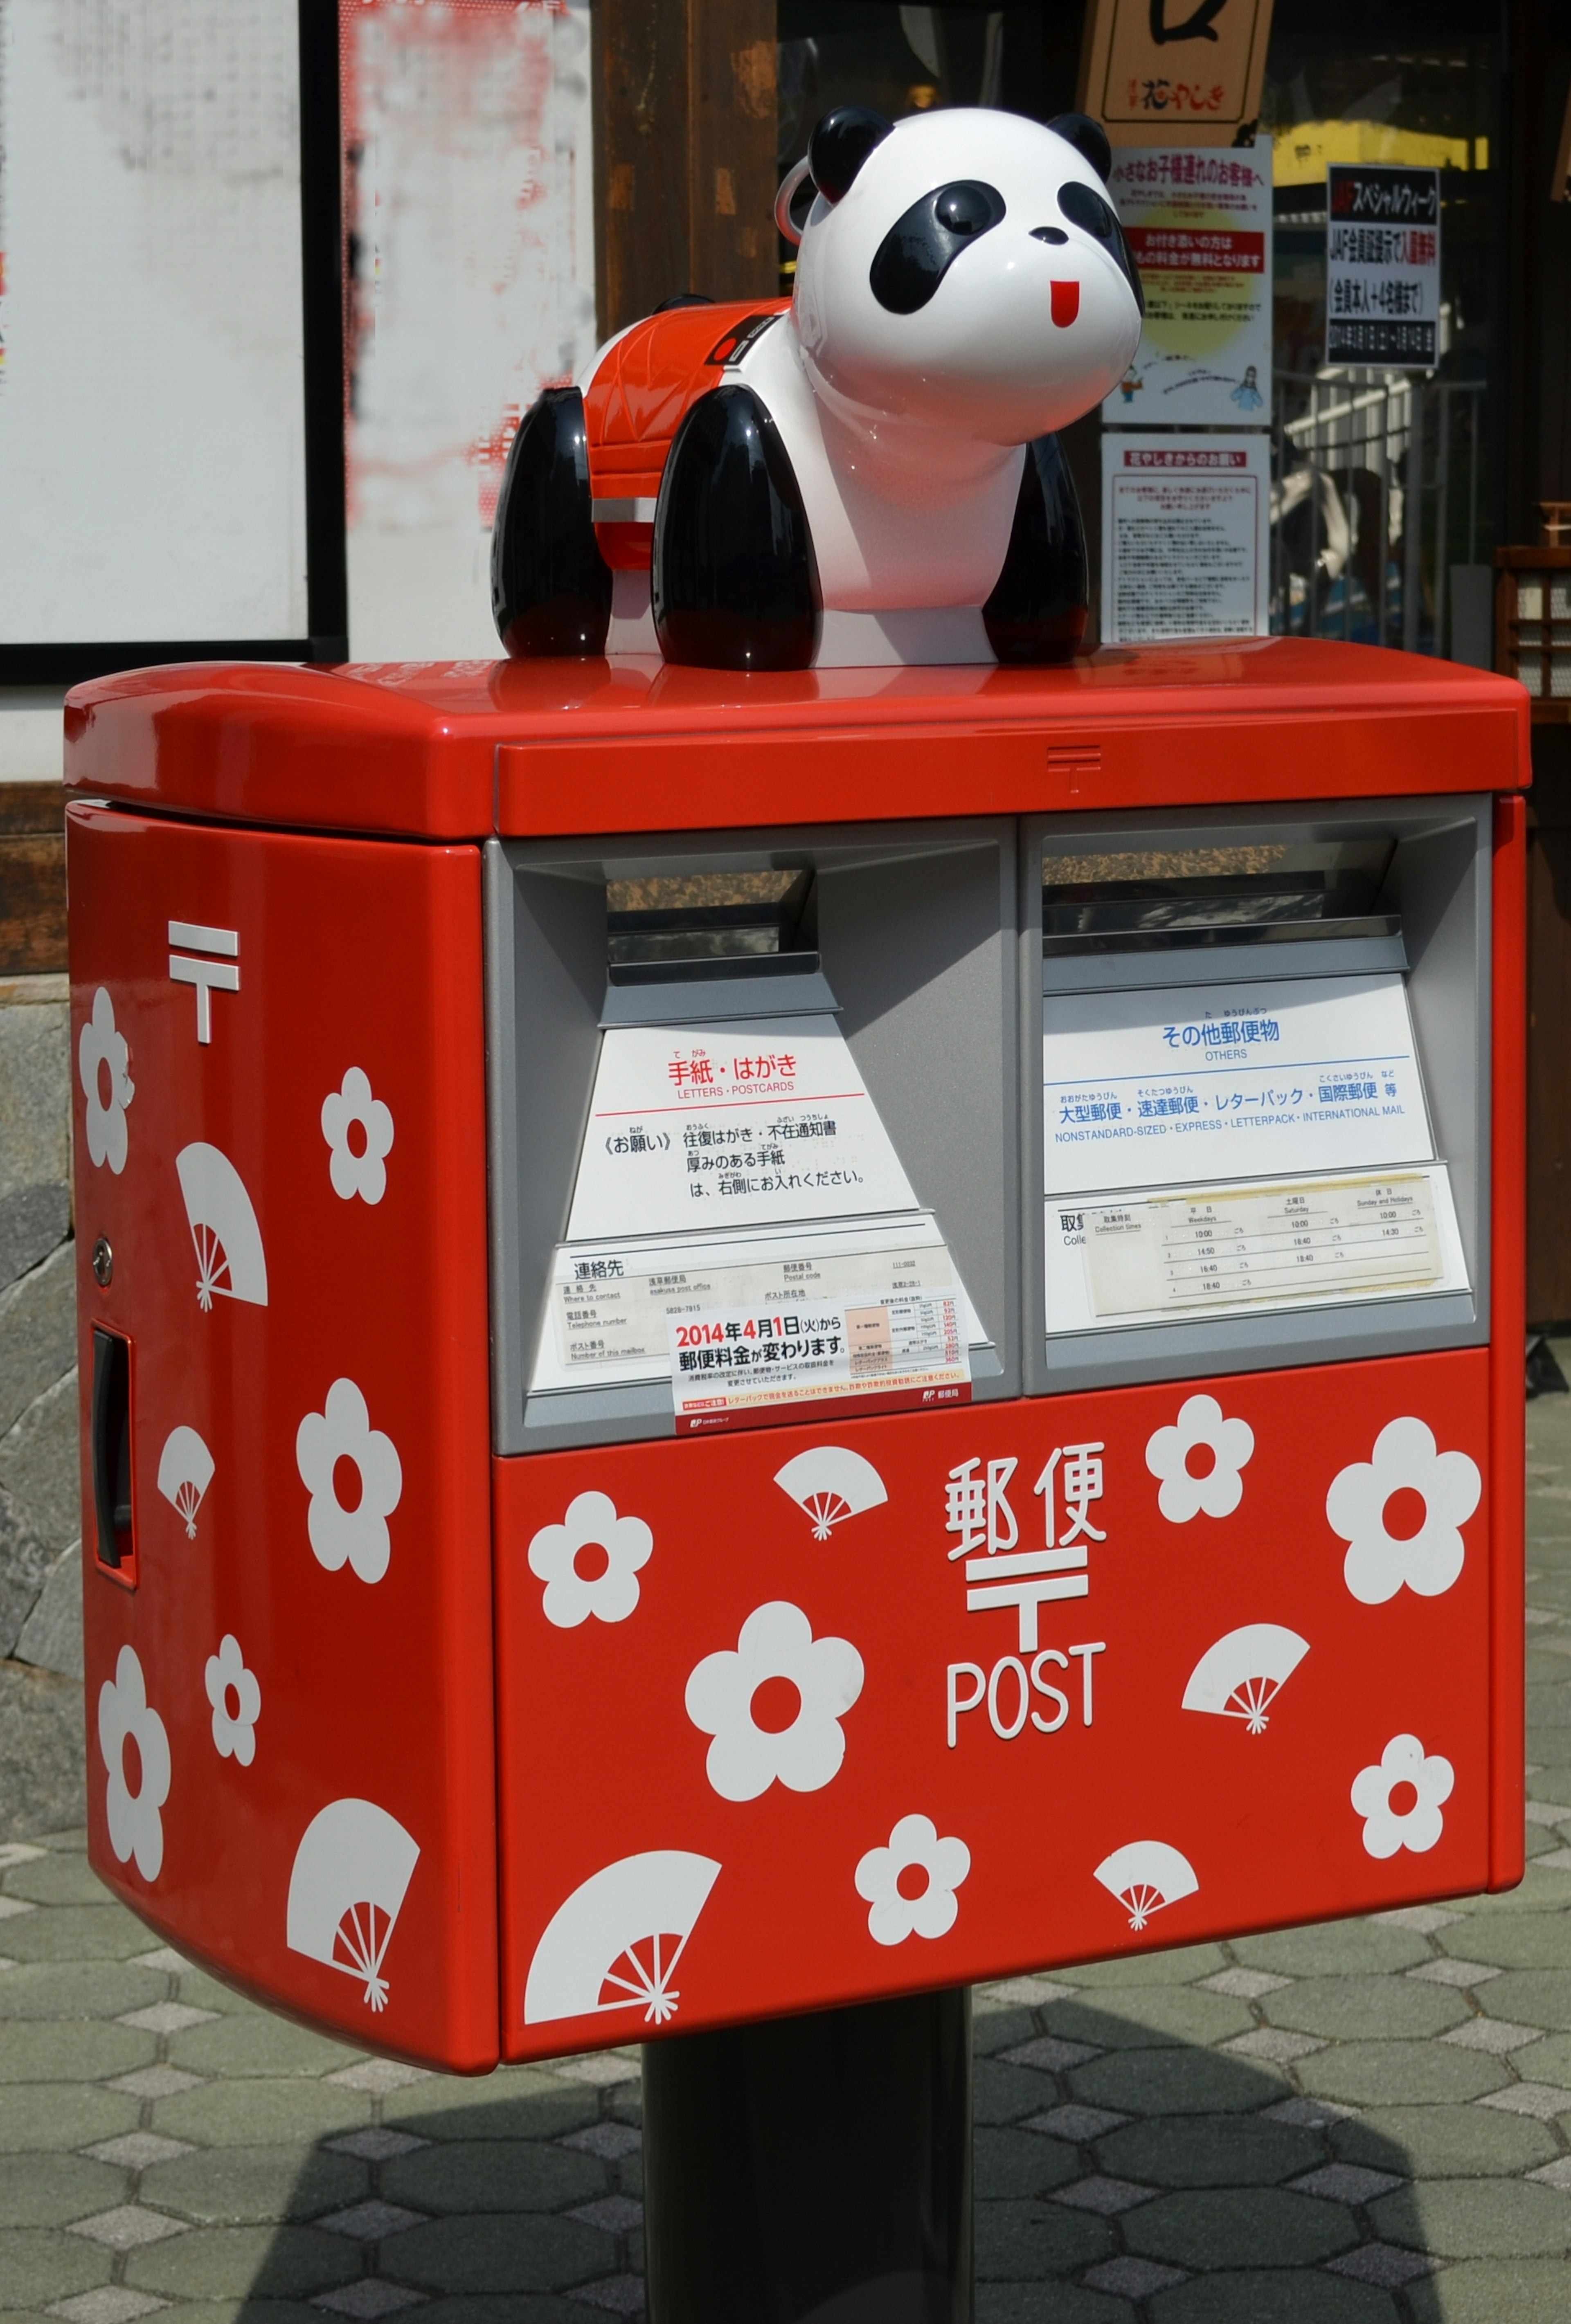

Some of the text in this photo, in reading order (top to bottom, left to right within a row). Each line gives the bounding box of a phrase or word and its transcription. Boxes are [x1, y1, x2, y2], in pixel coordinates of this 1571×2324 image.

[1113, 153, 1264, 188] 小さなお子様連れのお客様へ
[1146, 234, 1233, 250] お付き添いの方は
[1130, 453, 1242, 466] 花やしきからのお願い
[1224, 1007, 1267, 1017] ゆうびんぶつ
[1163, 1019, 1280, 1047] その他郵便物
[692, 1049, 706, 1058] がみ
[1205, 1049, 1247, 1061] OTHERS
[668, 1054, 796, 1086] 手紙・はがき
[1060, 1092, 1118, 1104] おおがたゆうびん
[1138, 1086, 1193, 1098] そくたつゆうびん
[1319, 1072, 1373, 1083] こくさいゆうびん
[1383, 1105, 1405, 1115] MAIL
[777, 1115, 795, 1124] ふざい
[629, 1126, 643, 1134] ねが
[605, 1121, 836, 1155] 《お願い》 往復はがき・不在通知書
[686, 1150, 785, 1173] 厚みのある手紙
[690, 1170, 864, 1198] は、右側にお入れください。
[1286, 1197, 1305, 1205] 土曜日
[1103, 1214, 1131, 1223] 取集時刻
[1195, 1230, 1213, 1238] 10:00
[1292, 1220, 1308, 1228] 10:00
[1380, 1211, 1397, 1219] 10:00
[1095, 1225, 1124, 1233] Collection
[1197, 1247, 1215, 1256] 14:50
[1382, 1228, 1399, 1236] 14:30
[574, 1259, 624, 1281] 連絡先
[783, 1262, 812, 1273] 郵便番号
[1200, 1265, 1218, 1273] 16:40
[649, 1274, 686, 1286] 浅草郵便局
[784, 1273, 804, 1282] Postal
[677, 1285, 692, 1293] post
[1203, 1282, 1220, 1290] 18:40
[564, 1295, 585, 1304] Where
[595, 1292, 621, 1301] contact
[765, 1288, 806, 1300] ポスト所在地
[567, 1310, 597, 1321] 電話番号
[567, 1317, 627, 1330] Telephone number
[675, 1316, 842, 1348] 2014年4月1日（火）から
[570, 1340, 605, 1351] ポスト番号
[571, 1351, 596, 1360] Number
[679, 1335, 845, 1372] 郵便料金が変わります。
[727, 1375, 797, 1388] 変更させていただきます。
[945, 1441, 1107, 1562] 郵便
[947, 1641, 1107, 1749] POST
